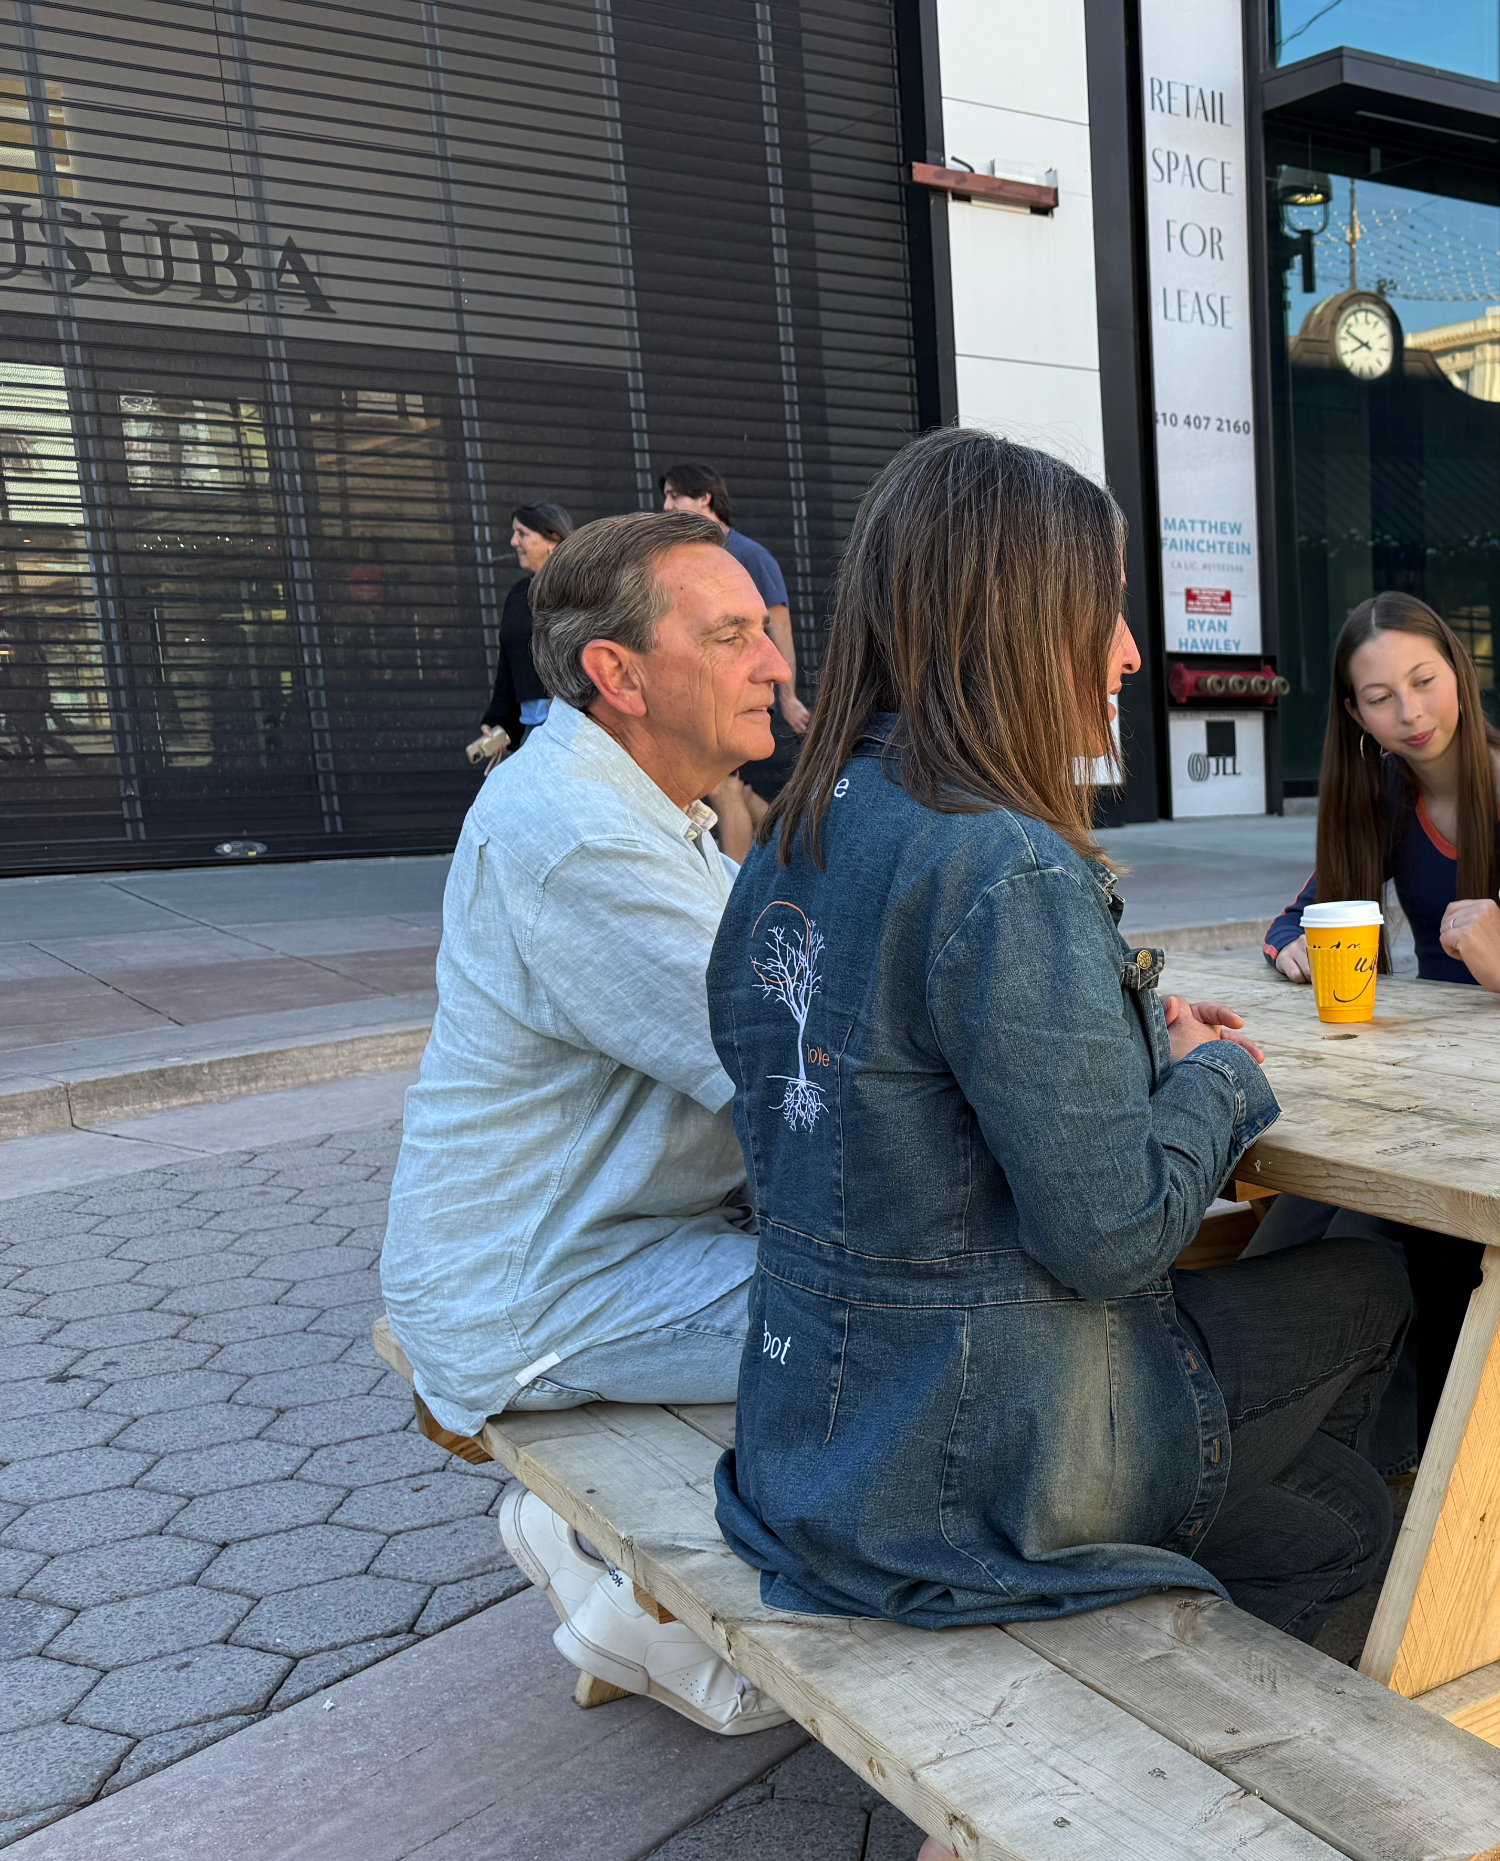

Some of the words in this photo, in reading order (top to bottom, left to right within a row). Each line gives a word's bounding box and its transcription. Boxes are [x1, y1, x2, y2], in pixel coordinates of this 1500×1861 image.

[1149, 76, 1232, 128] RETAIL
[1151, 147, 1234, 196] SPACE
[1166, 219, 1224, 261] FOR
[1163, 287, 1233, 330] LEASE
[1184, 414, 1211, 431] 407
[1216, 418, 1251, 435] 2160
[1163, 517, 1243, 536] MATTHEW
[1160, 537, 1252, 556] FAINCHTEIN
[1187, 618, 1228, 633] RYAN
[1178, 637, 1241, 652] HAWLEY
